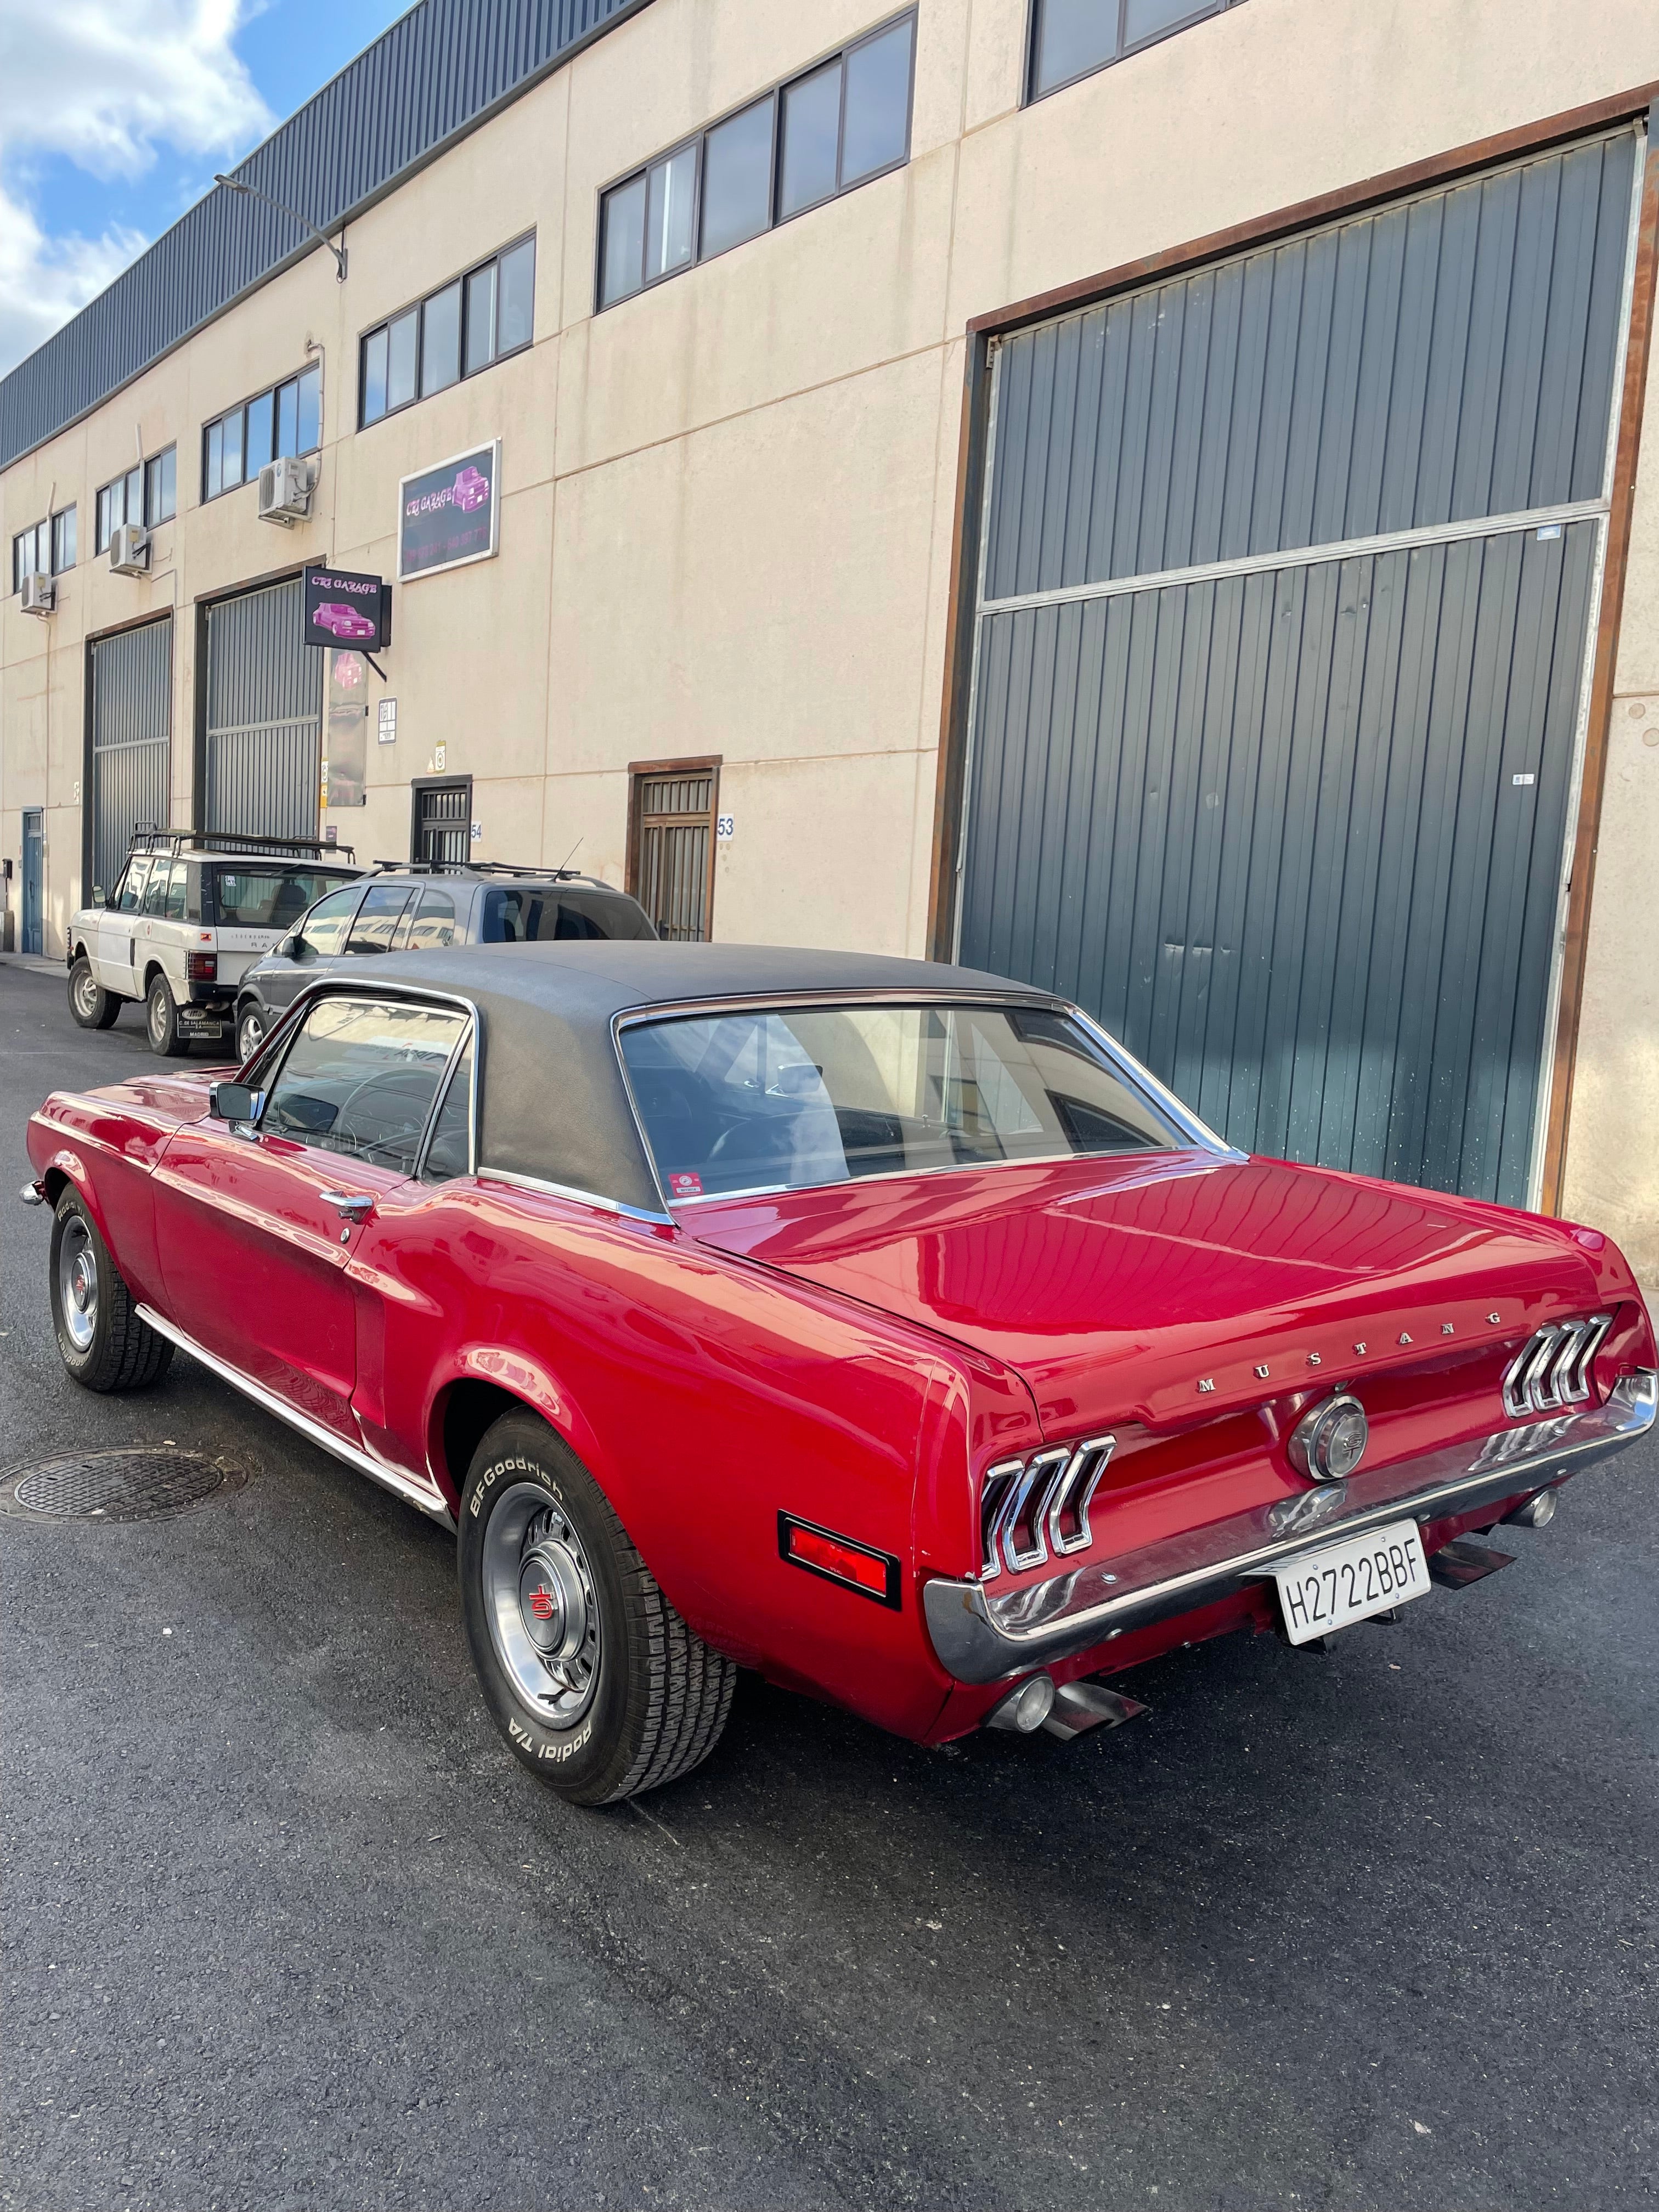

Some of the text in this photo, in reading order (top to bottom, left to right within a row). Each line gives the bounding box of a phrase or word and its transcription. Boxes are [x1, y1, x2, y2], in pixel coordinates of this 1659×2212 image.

[421, 487, 452, 512] GARAGE
[333, 579, 377, 595] GARAGE
[471, 825, 482, 839] 54
[718, 818, 733, 836] 53
[1197, 1312, 1502, 1393] MUSTANG
[1344, 1432, 1362, 1460] GT
[470, 1457, 563, 1518] BFGoodrich
[1286, 1538, 1417, 1629] H2722BBF
[528, 1584, 554, 1620] GT
[509, 1717, 592, 1763] Radial T/A
